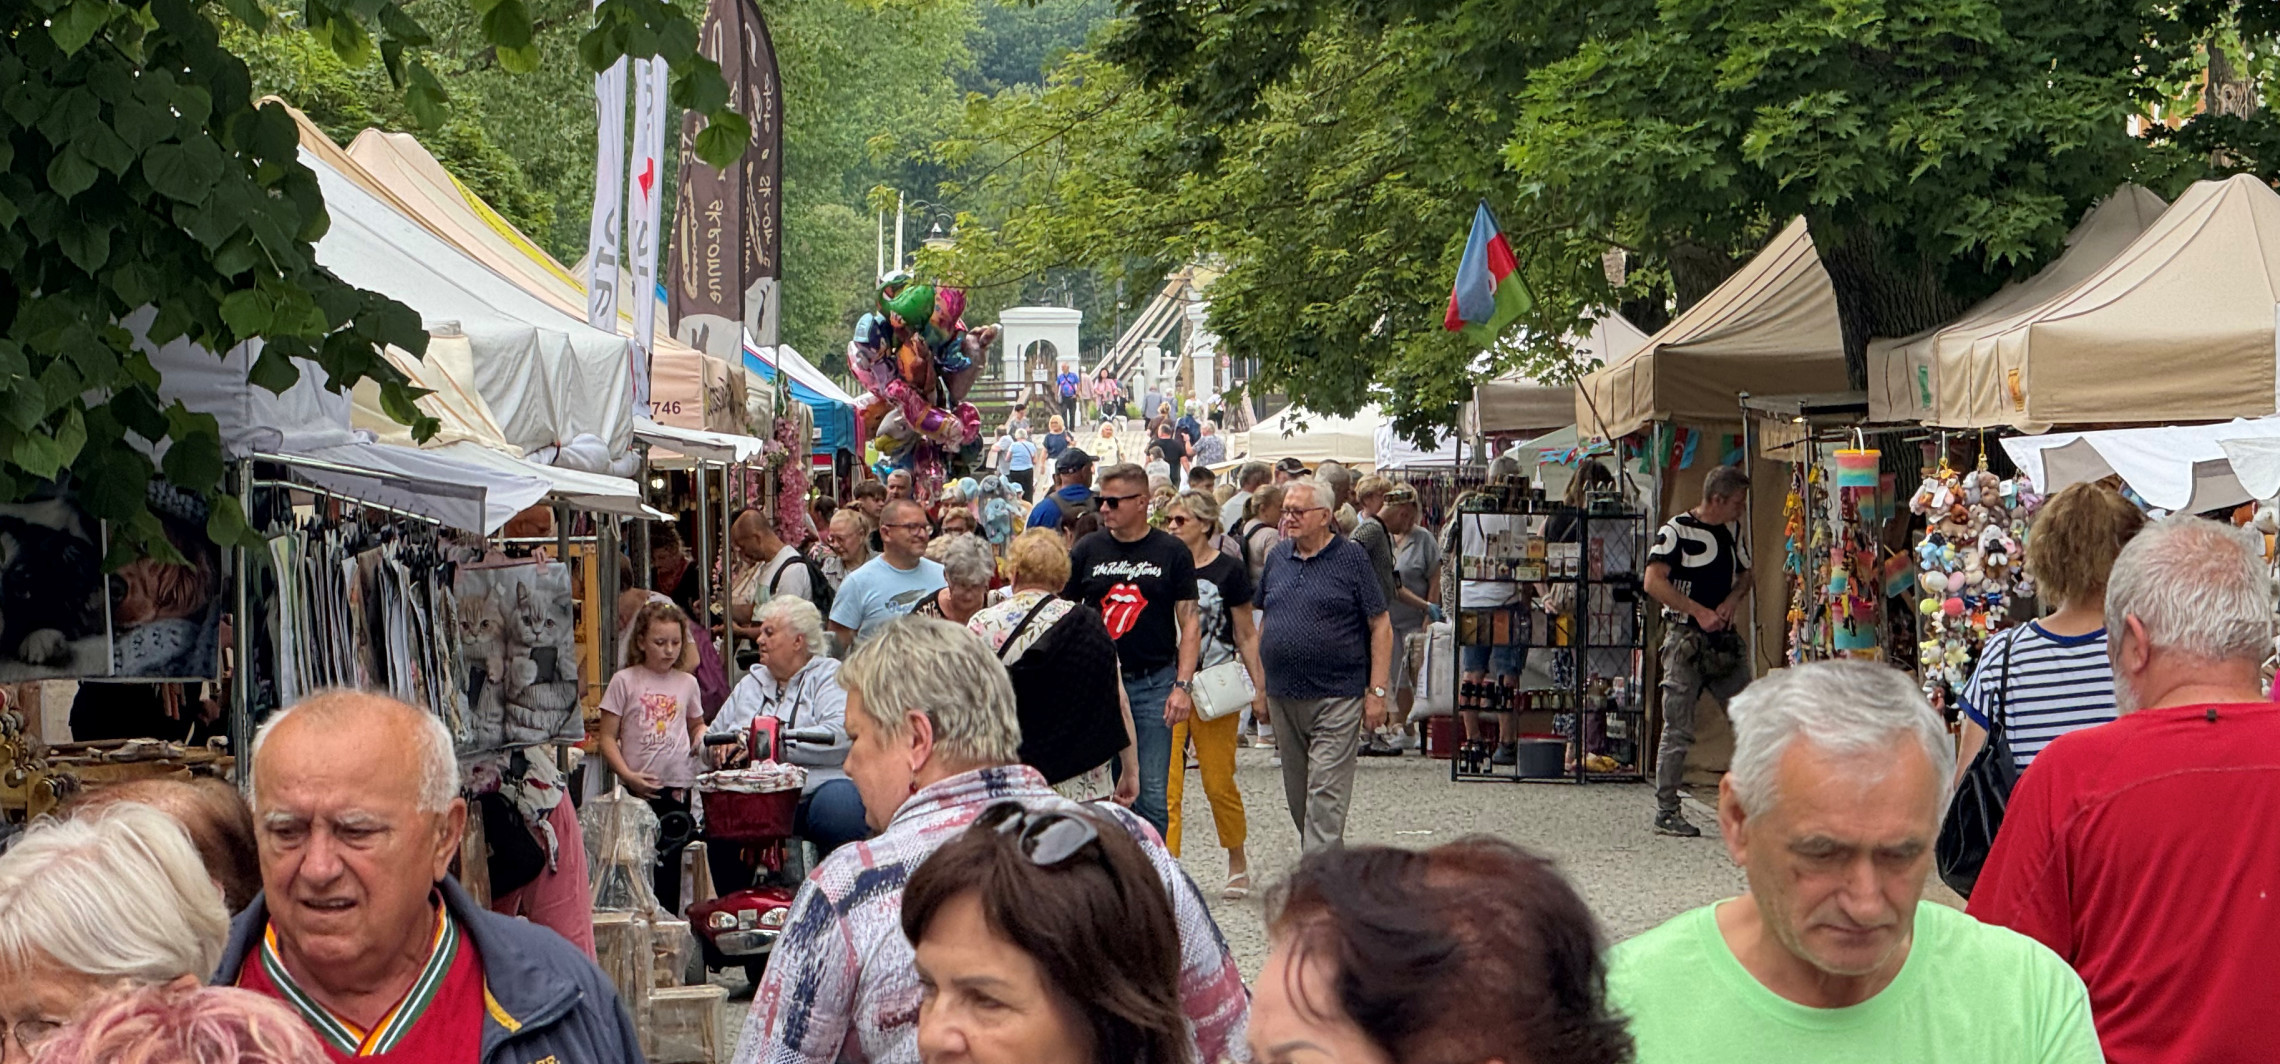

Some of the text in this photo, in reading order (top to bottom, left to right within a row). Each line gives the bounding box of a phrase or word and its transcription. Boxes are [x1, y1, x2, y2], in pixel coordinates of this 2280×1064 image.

[652, 400, 682, 416] 746
[1106, 560, 1137, 581] Rolling
[1134, 560, 1162, 578] Stones
